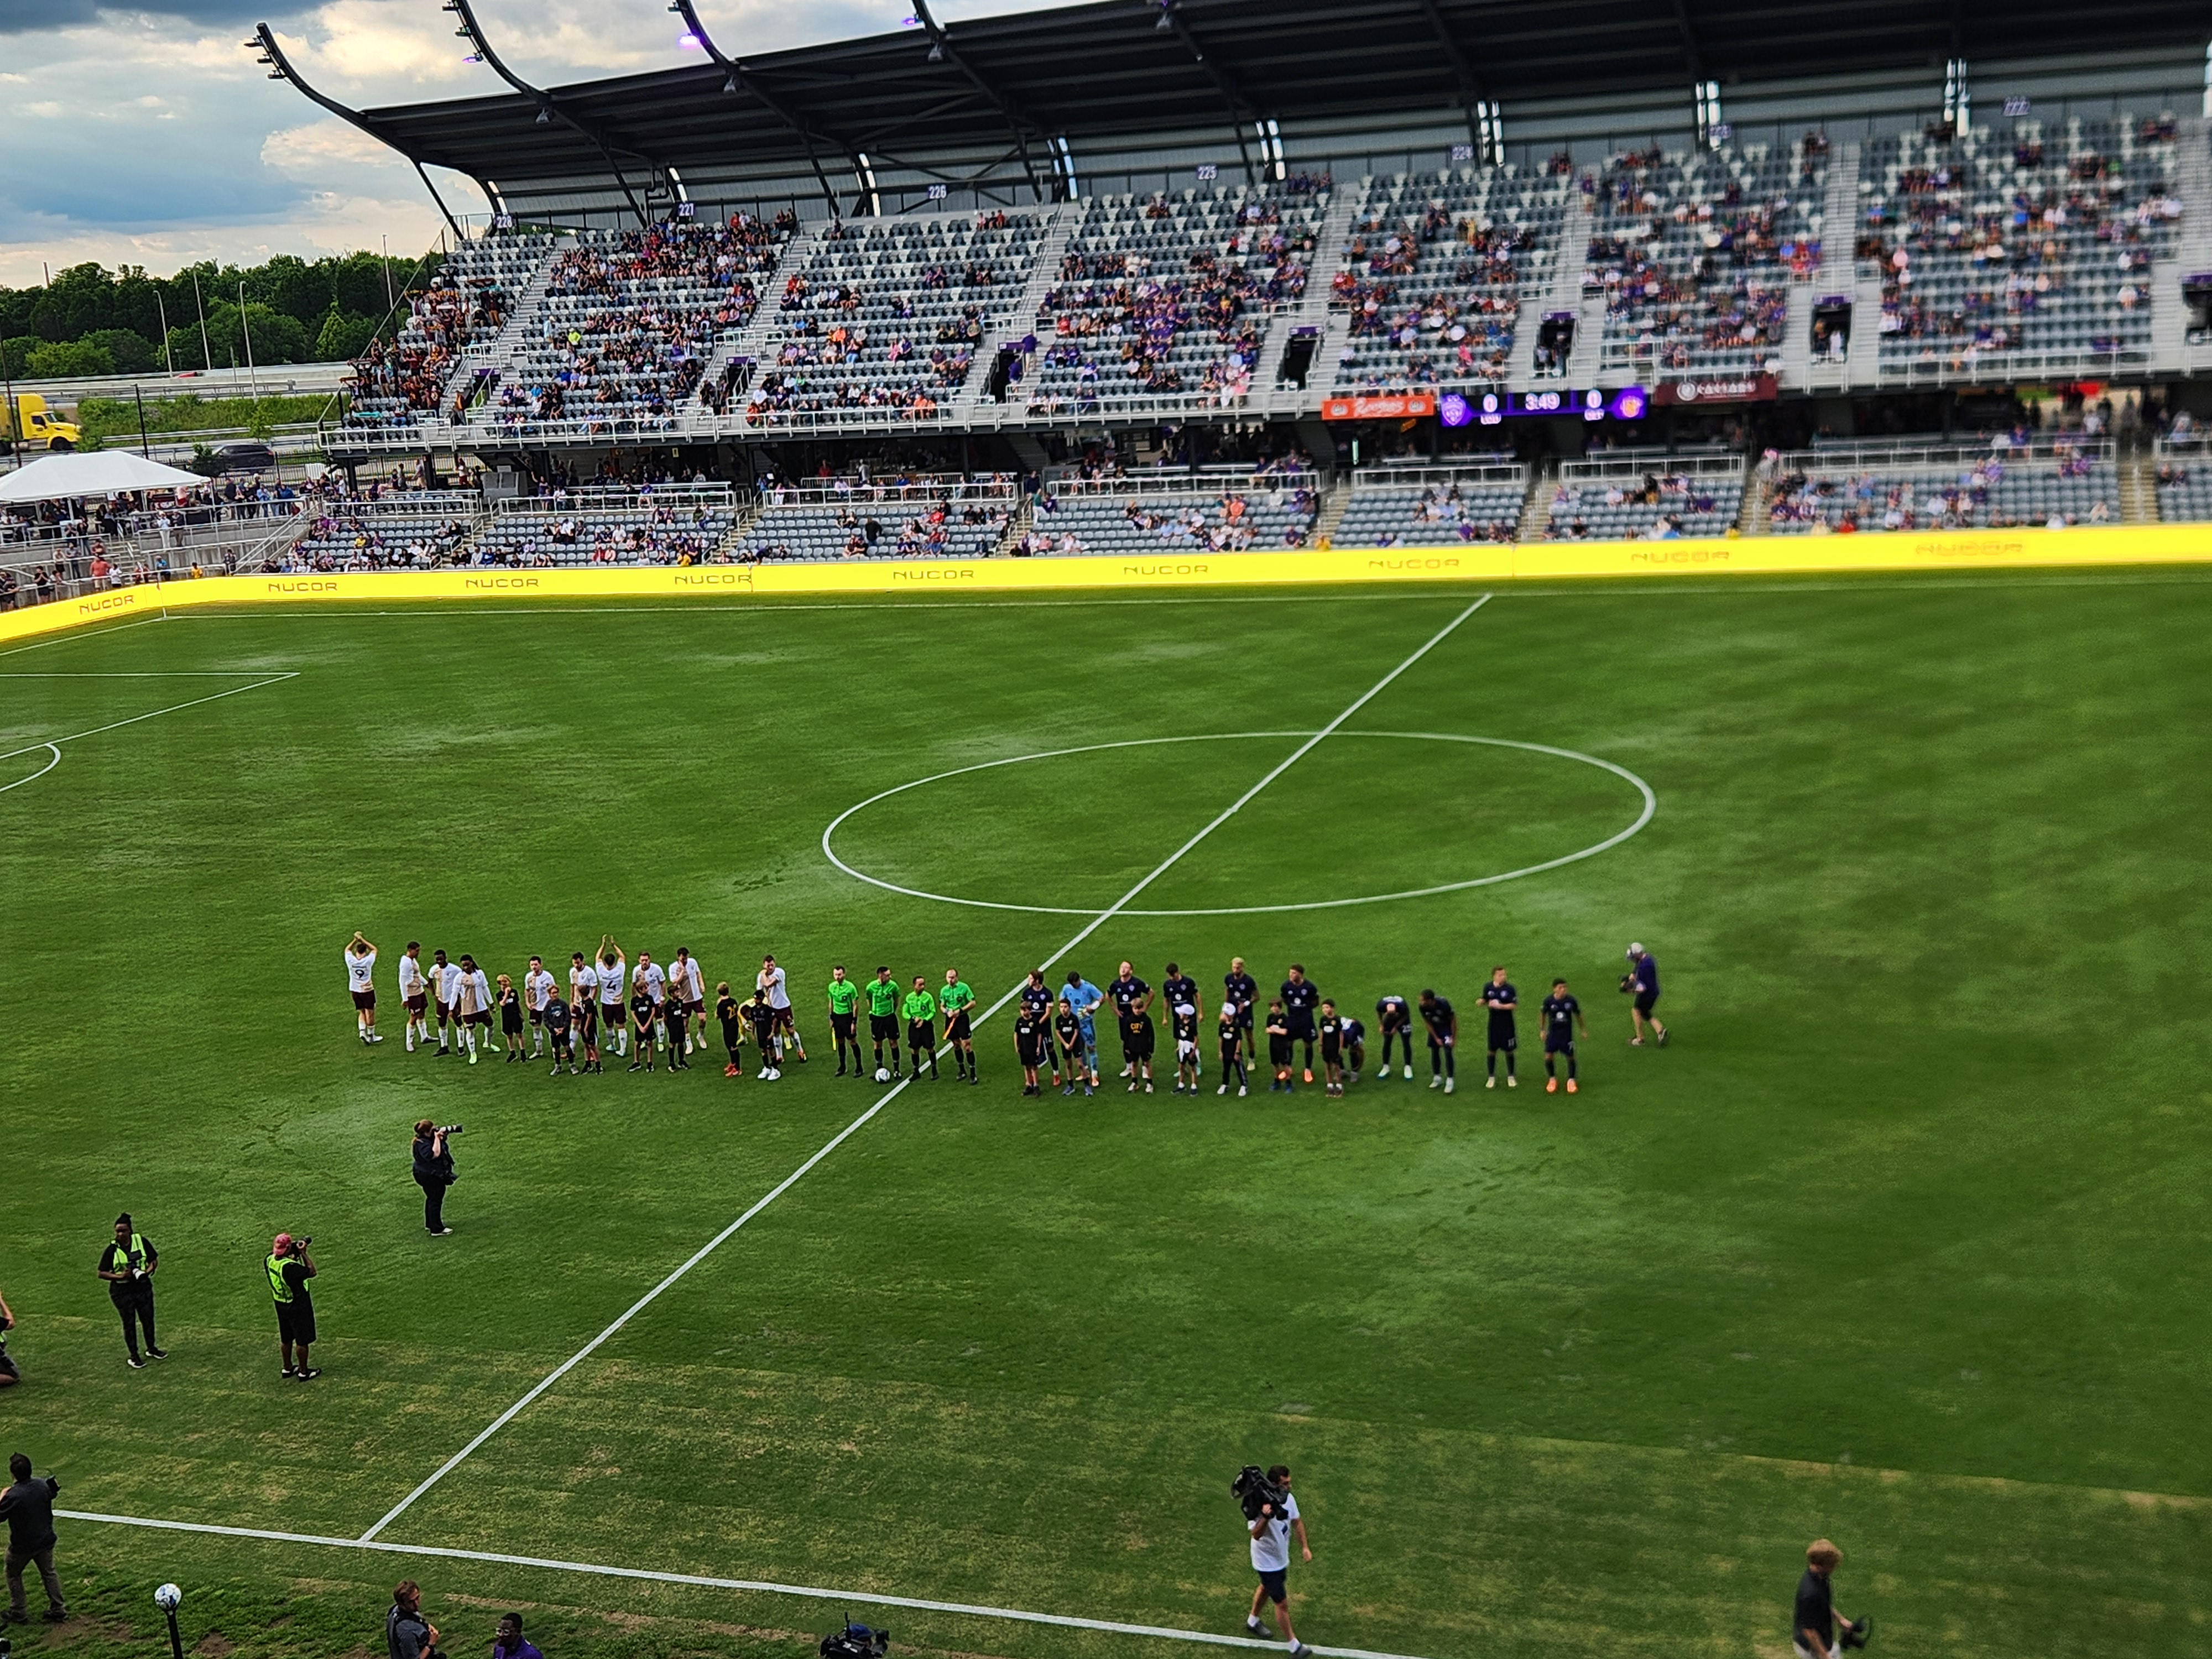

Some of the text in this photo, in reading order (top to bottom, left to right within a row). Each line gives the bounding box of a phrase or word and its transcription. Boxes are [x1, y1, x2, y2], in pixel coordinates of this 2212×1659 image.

[1198, 166, 1217, 180] 225
[497, 215, 512, 228] 228
[1483, 394, 1498, 413] 0
[1525, 393, 1560, 410] 3:49
[1587, 389, 1602, 409] 0
[1631, 551, 1729, 563] NUCOR
[1369, 559, 1459, 569] NUCOR
[893, 570, 974, 580] NUCOR
[1124, 565, 1208, 575] NUCOR
[466, 578, 539, 588] NUCOR
[675, 575, 752, 585] NUCOR
[268, 582, 337, 592] NUCOR
[79, 594, 134, 614] NUCOR
[355, 969, 365, 979] 9
[606, 980, 617, 991] 4
